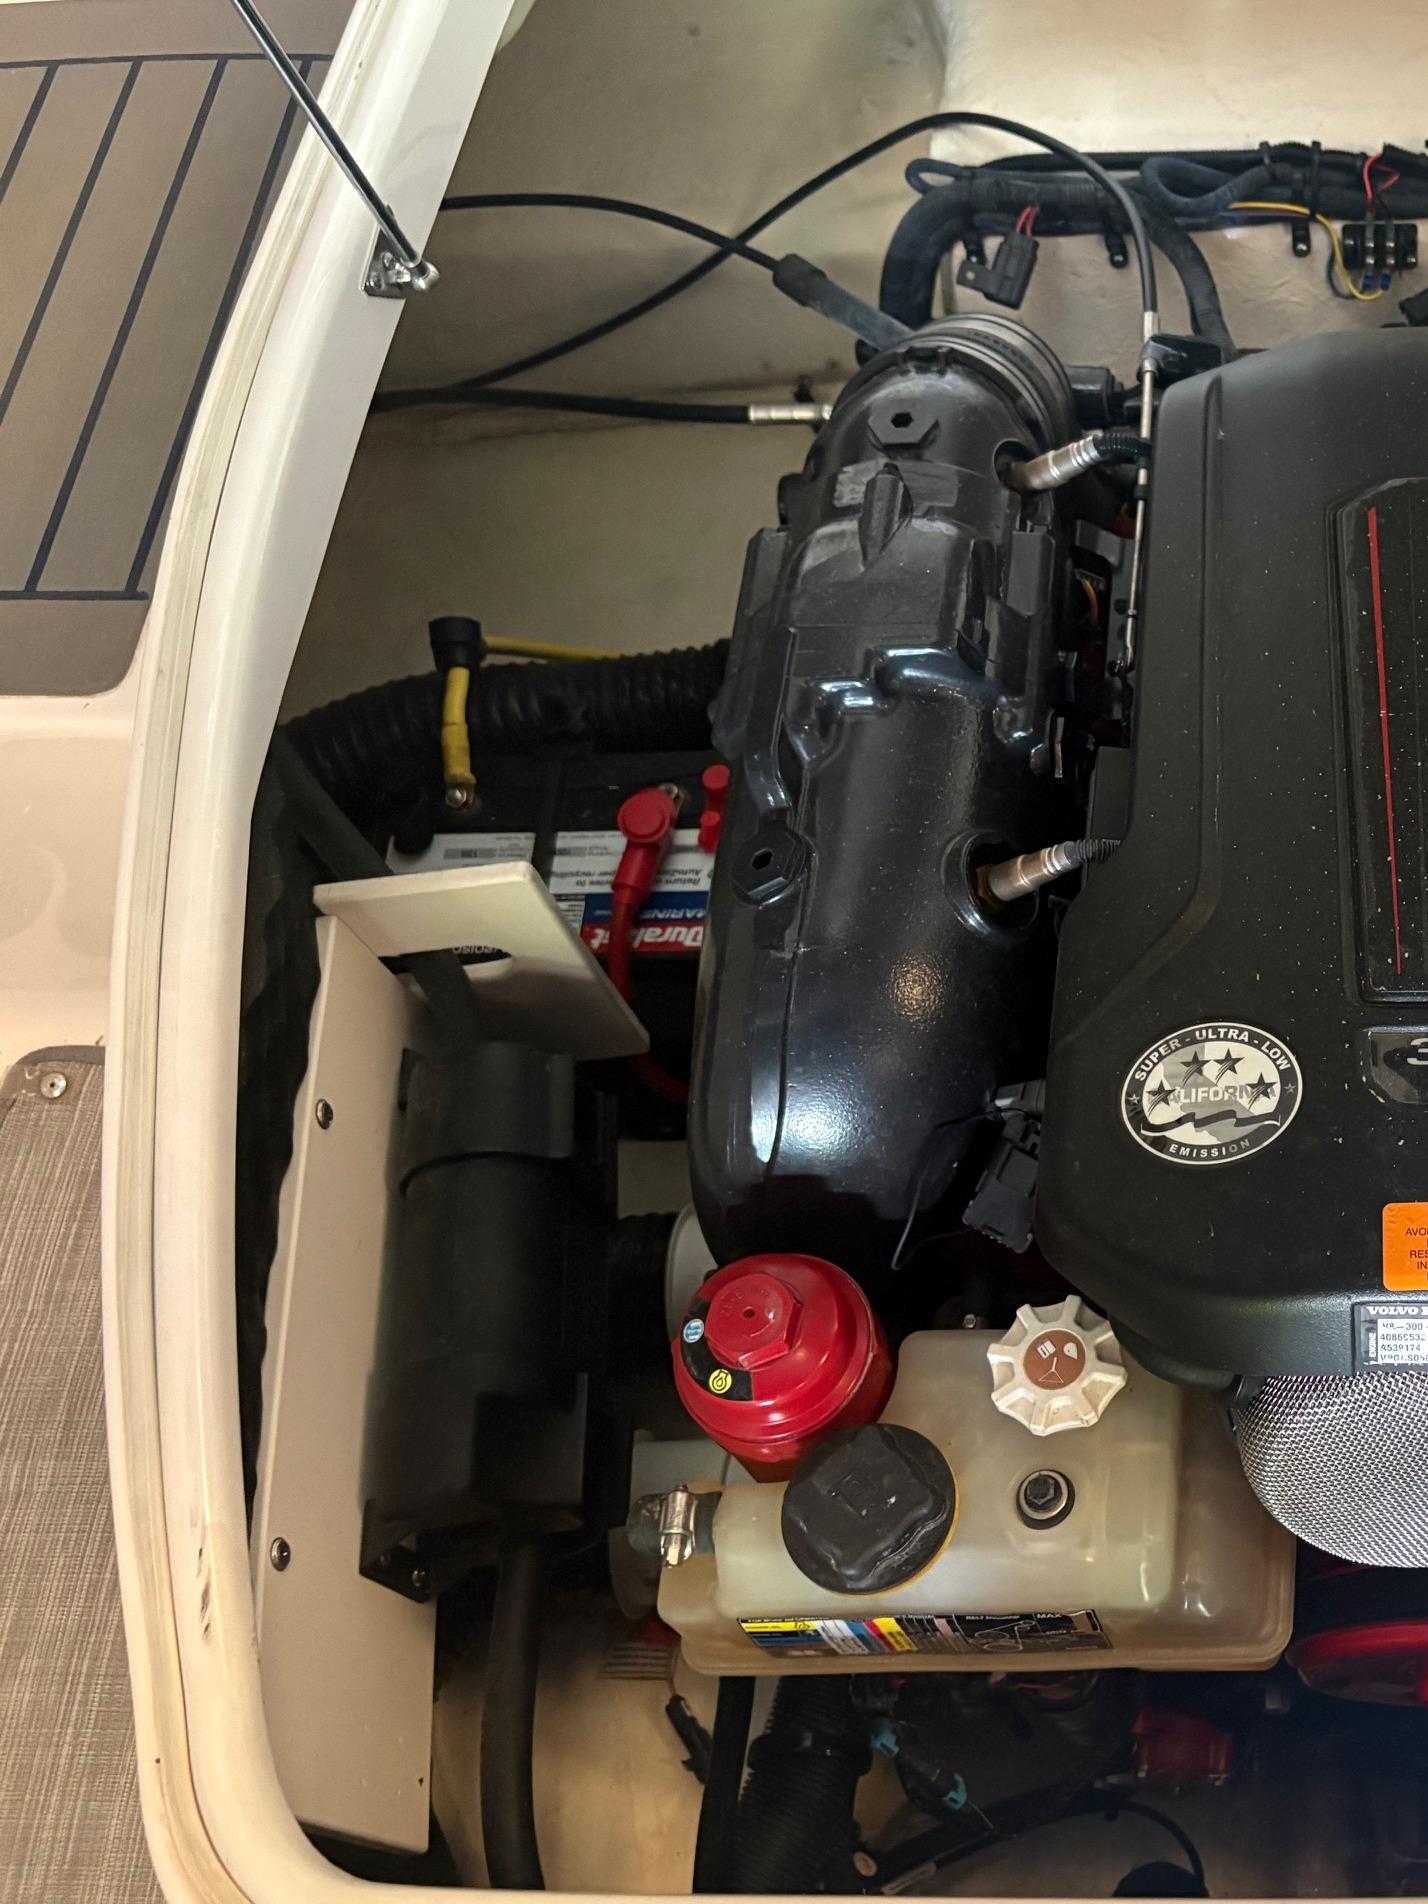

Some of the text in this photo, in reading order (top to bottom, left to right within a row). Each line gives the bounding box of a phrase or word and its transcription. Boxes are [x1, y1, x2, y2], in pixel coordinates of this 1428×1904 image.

[591, 926, 703, 949] Duralt
[1135, 1038, 1181, 1081] SUPER
[1195, 1028, 1249, 1043] ULTRA
[1261, 1041, 1291, 1071] LOW
[1169, 1139, 1250, 1158] EMISSION
[1366, 1306, 1419, 1316] VOLVO
